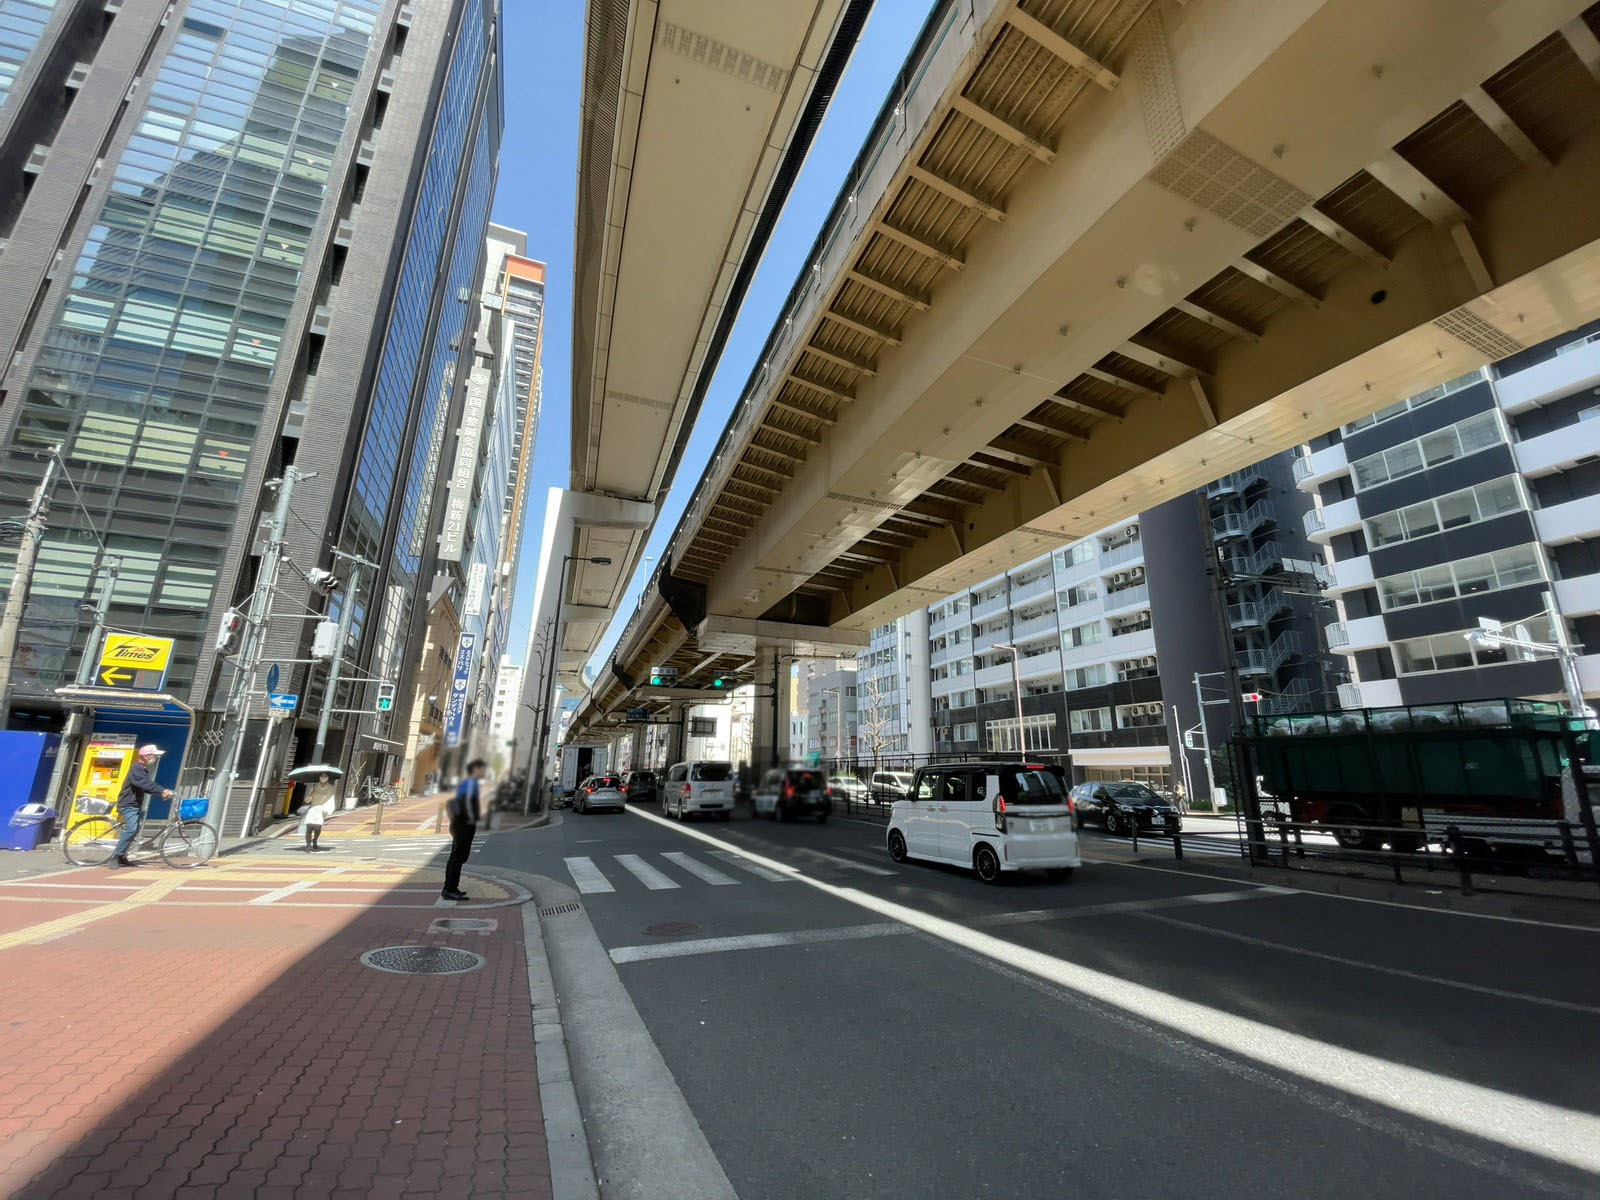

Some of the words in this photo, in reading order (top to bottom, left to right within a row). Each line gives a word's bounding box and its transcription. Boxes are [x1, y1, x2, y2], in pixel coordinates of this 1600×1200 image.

[443, 498, 465, 553] 梅新21ビル
[115, 645, 154, 660] Times
